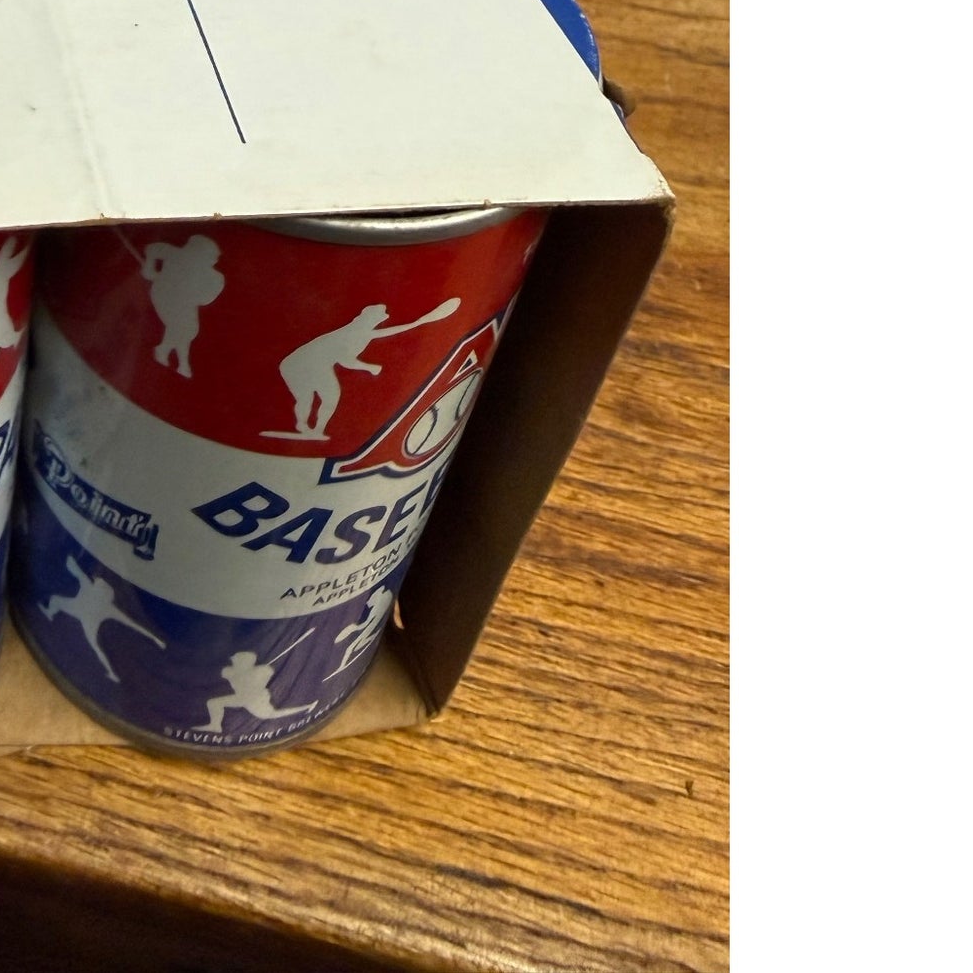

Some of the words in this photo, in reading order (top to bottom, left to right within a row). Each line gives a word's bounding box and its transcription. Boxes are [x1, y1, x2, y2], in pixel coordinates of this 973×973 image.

[279, 542, 402, 600] APPLETON
[312, 556, 400, 606] APPLETON
[238, 727, 283, 744] POINT
